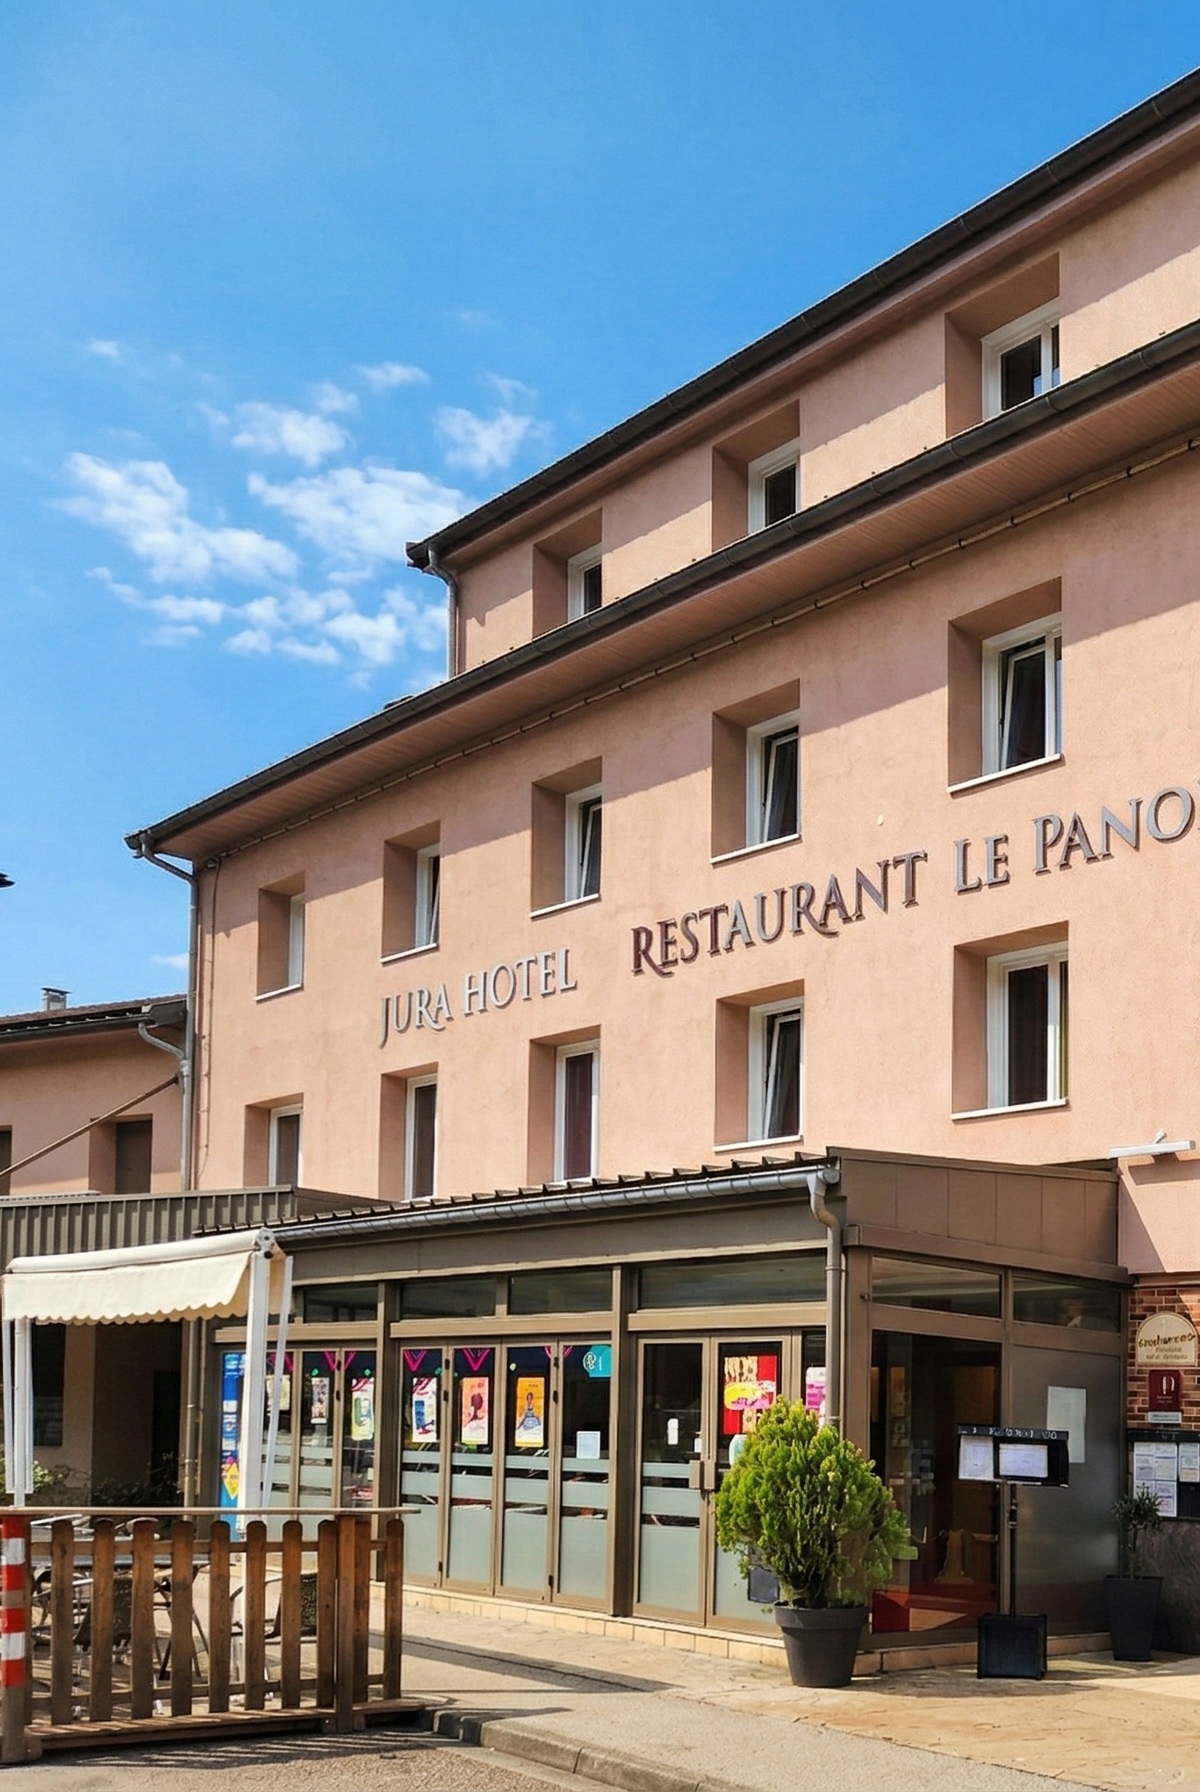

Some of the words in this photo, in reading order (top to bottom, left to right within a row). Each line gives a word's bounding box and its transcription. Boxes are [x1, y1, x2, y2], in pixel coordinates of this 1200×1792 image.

[631, 851, 928, 977] RESTAURANT
[954, 833, 1010, 894] LE
[379, 982, 452, 1048] JURA
[463, 946, 578, 1016] HOTEL
